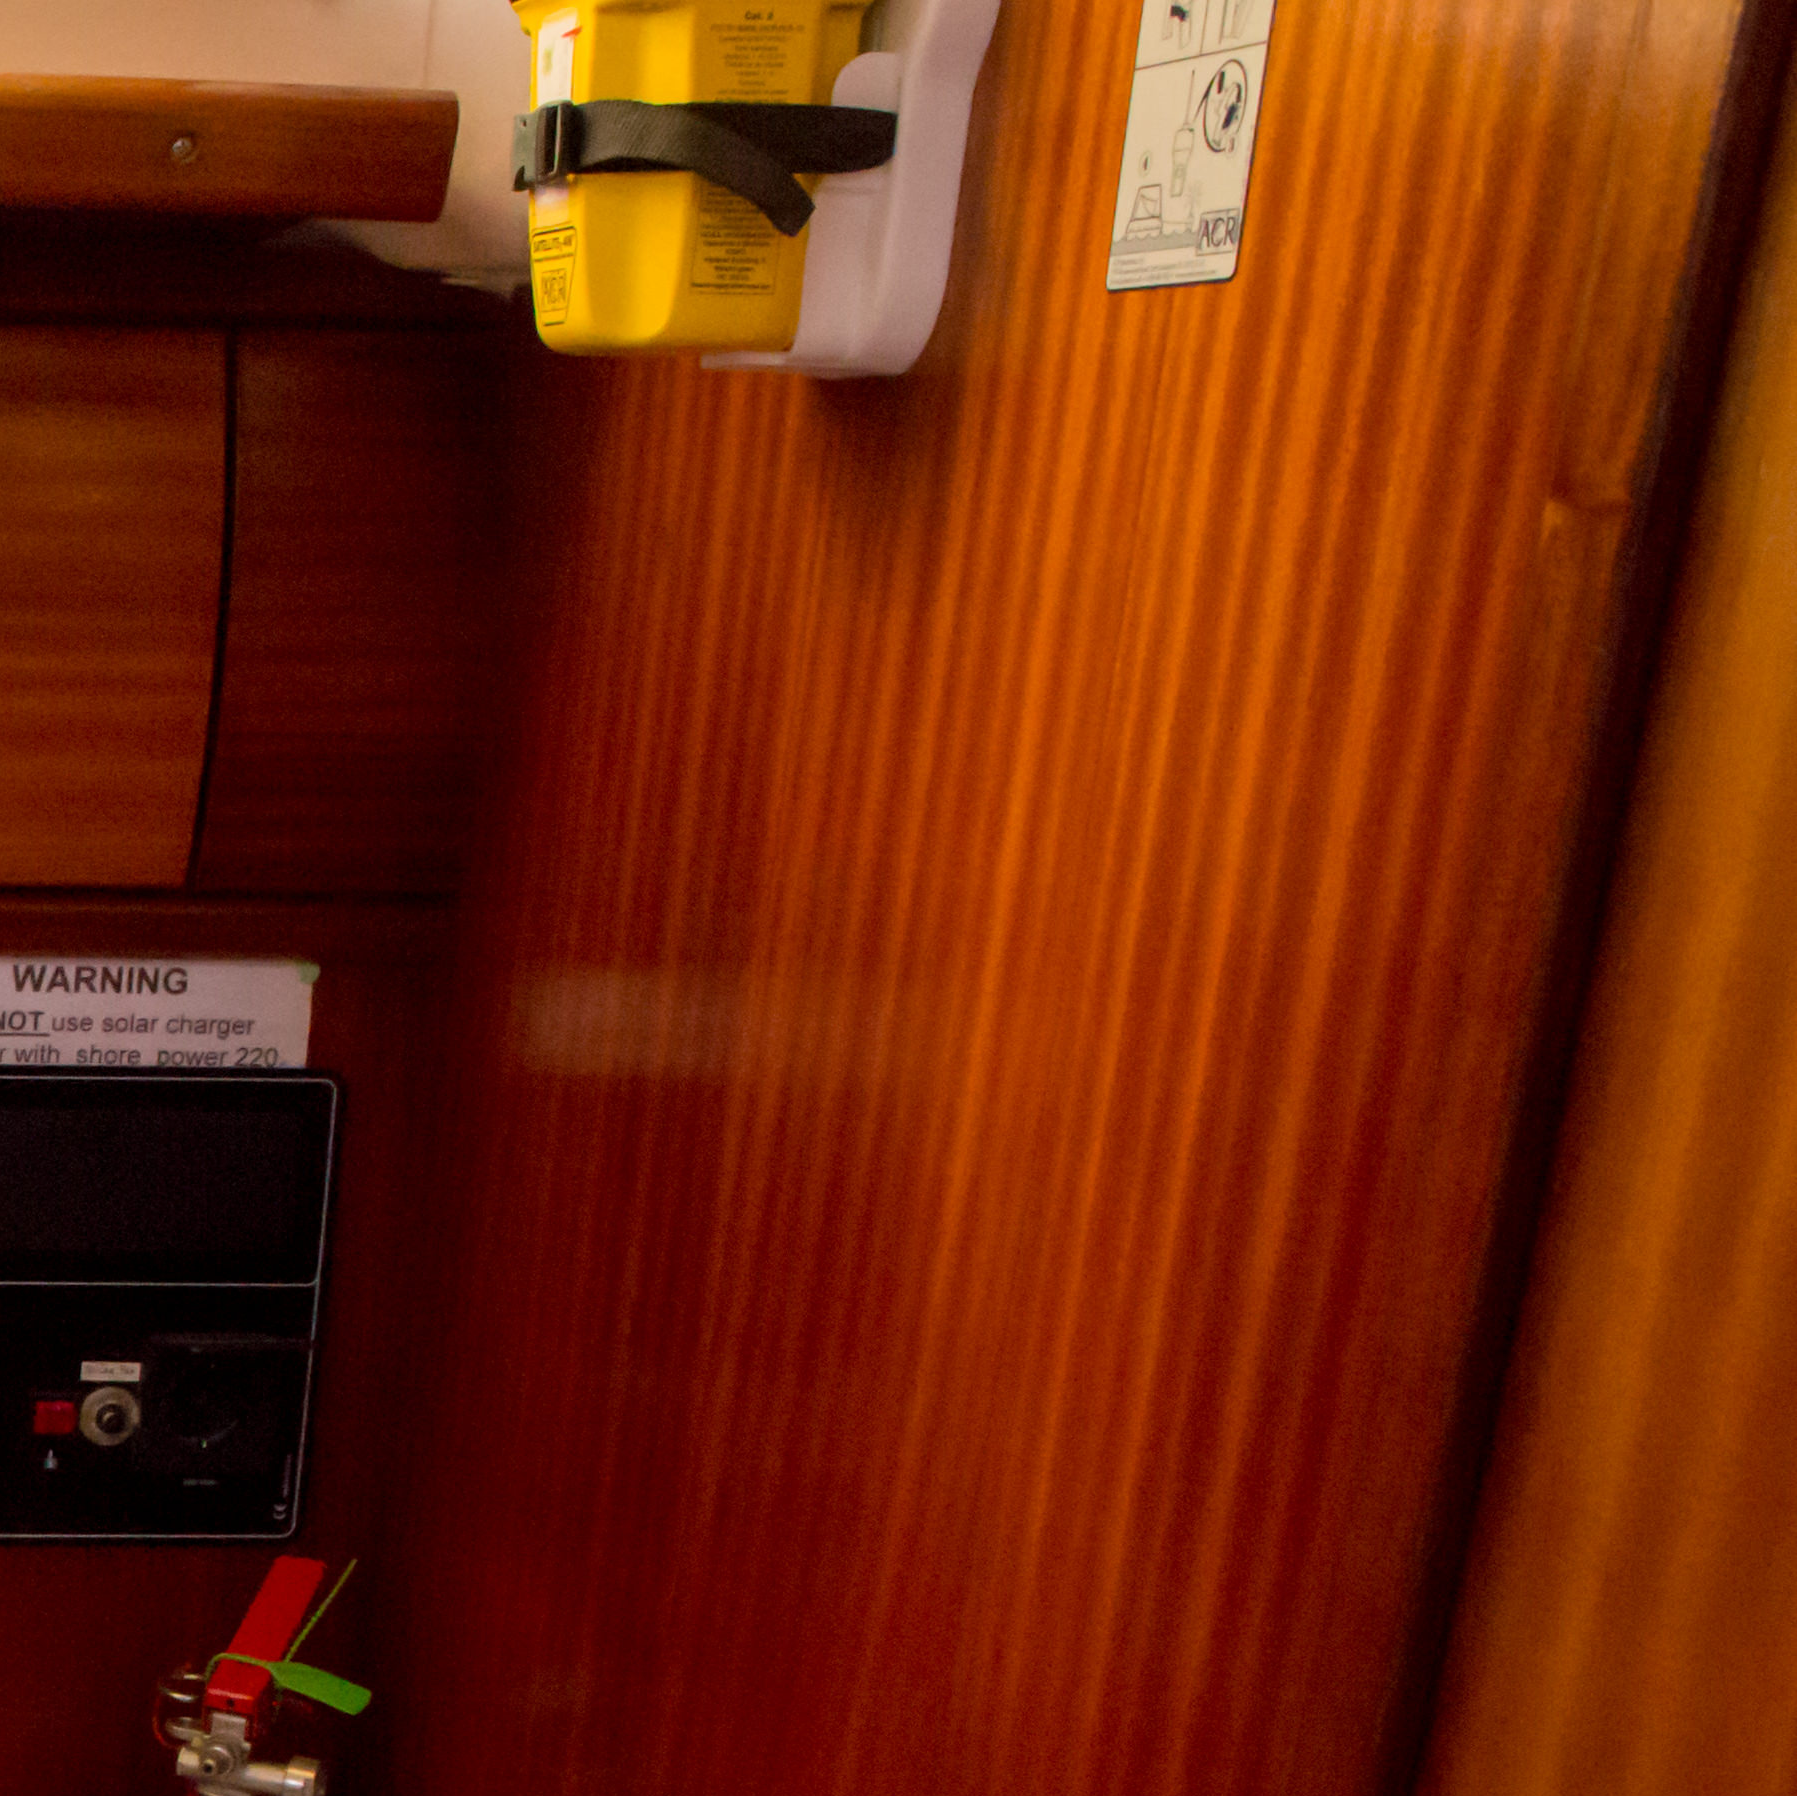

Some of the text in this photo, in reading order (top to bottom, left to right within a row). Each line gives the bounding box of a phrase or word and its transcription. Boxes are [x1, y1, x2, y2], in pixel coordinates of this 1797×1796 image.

[1198, 216, 1238, 250] ACR
[12, 963, 190, 995] WARNING
[51, 1015, 94, 1033] use
[102, 1011, 159, 1034] solar
[165, 1012, 255, 1040] charger
[14, 1044, 60, 1064] with
[76, 1045, 141, 1066] shore
[157, 1048, 228, 1067] power
